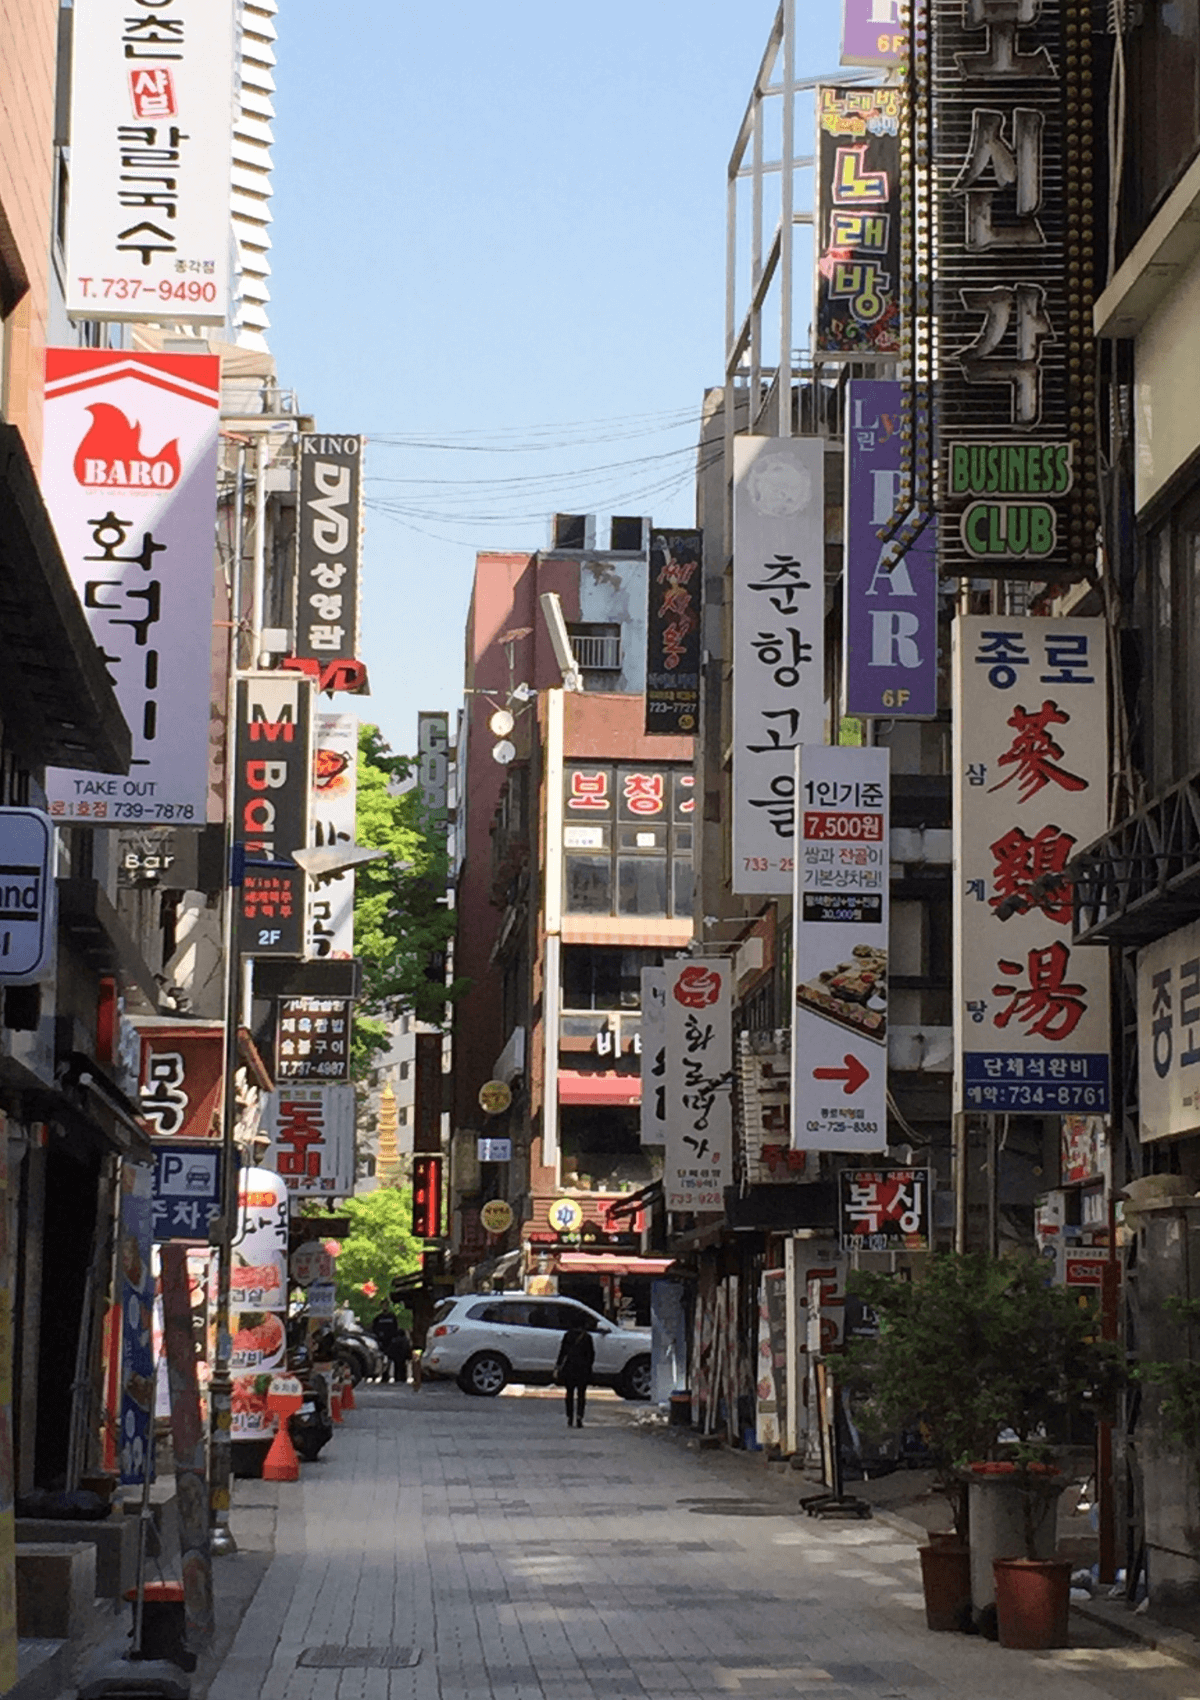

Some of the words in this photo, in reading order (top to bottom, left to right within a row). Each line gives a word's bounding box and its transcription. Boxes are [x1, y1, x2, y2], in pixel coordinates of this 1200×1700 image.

[832, 146, 892, 323] 노래방
[174, 260, 216, 275] 종각점
[304, 434, 360, 455] KINO
[84, 457, 175, 487] BARO
[952, 443, 1070, 494] BUSINESS
[964, 504, 1055, 554] CLUB
[975, 630, 1096, 690] 종로
[881, 688, 911, 708] 6F
[73, 778, 118, 796] TAKE
[122, 780, 158, 797] OUT
[567, 771, 695, 815] 보청
[803, 780, 884, 808] 1인기준
[113, 802, 195, 819] 739-7878
[806, 815, 880, 839] 7,500원
[0, 878, 39, 909] nd
[258, 929, 282, 946] 2F
[983, 1057, 1088, 1078] 단체석완비
[163, 1157, 184, 1185] P
[844, 1181, 922, 1234] 복싱
